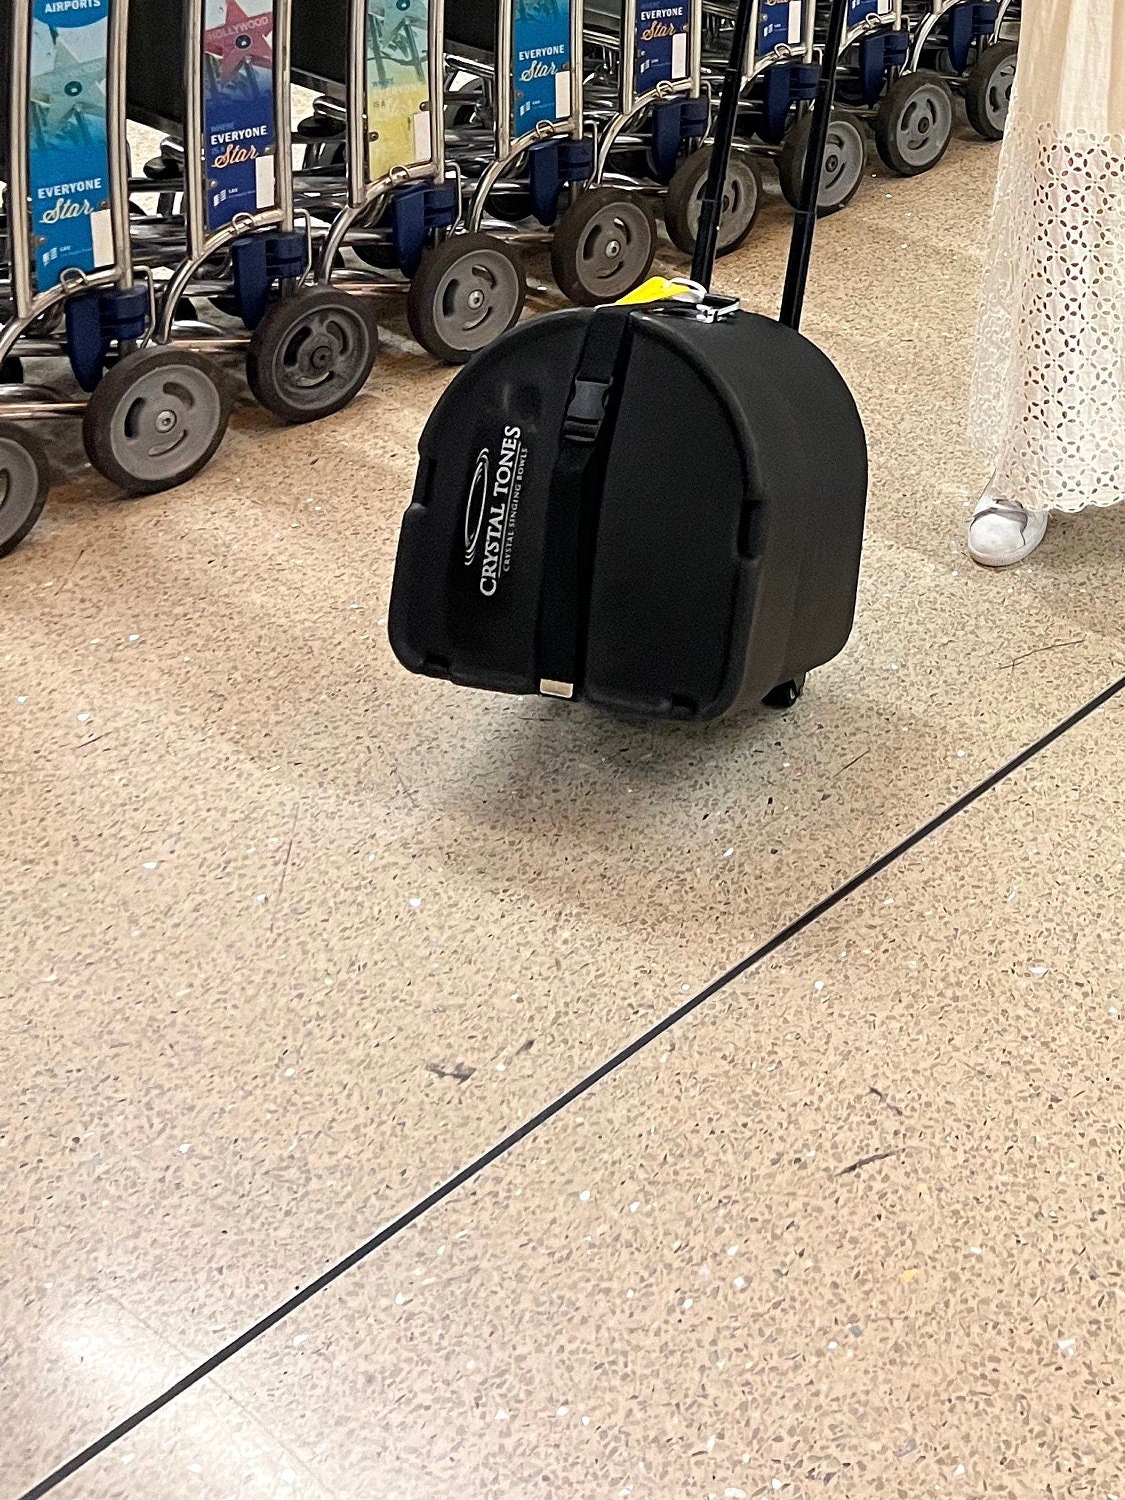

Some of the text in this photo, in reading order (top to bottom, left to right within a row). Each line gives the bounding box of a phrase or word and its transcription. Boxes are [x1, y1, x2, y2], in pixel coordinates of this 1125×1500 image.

[640, 6, 684, 21] EVERYONE
[640, 20, 677, 41] Star
[518, 44, 565, 60] EVERYONE
[518, 60, 558, 82] Star
[211, 125, 268, 146] EVERYONE
[211, 144, 259, 169] Star
[38, 178, 102, 199] EVERYONE
[38, 198, 94, 224] Star
[480, 425, 521, 596] CRYSTAL TONES
[502, 447, 528, 573] CRYSTAL SINGING BOWLS
